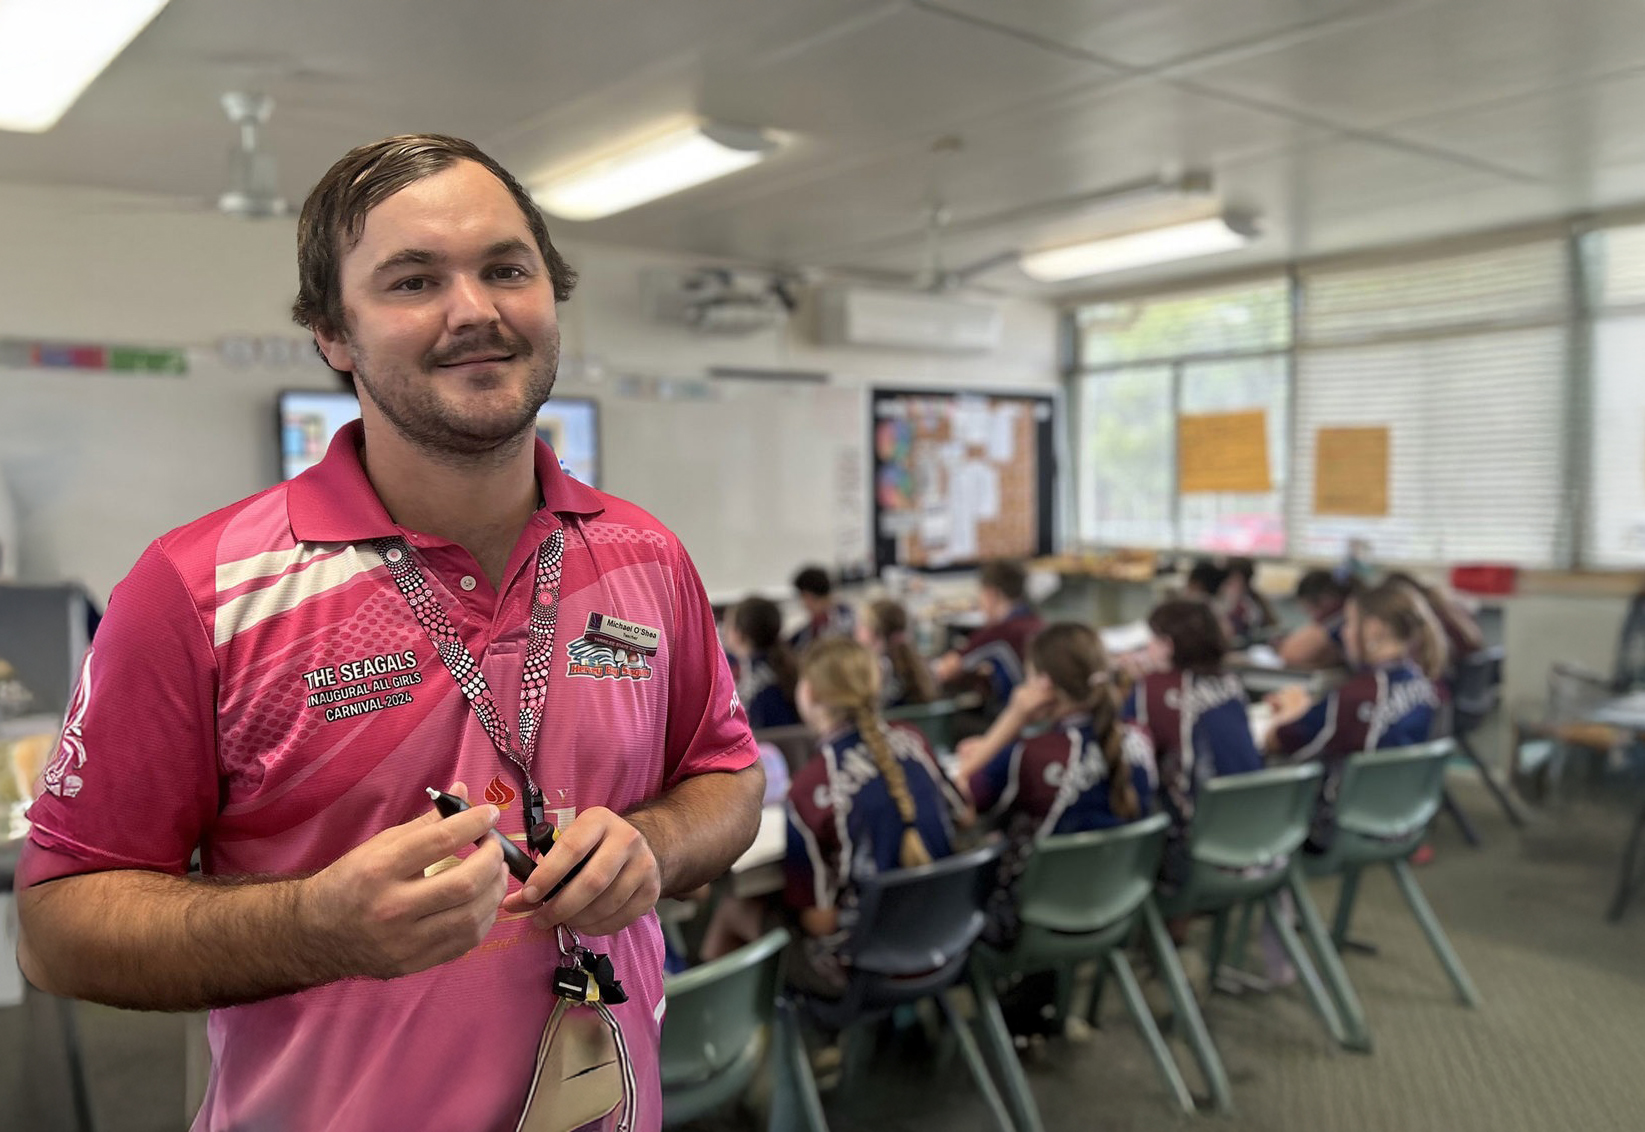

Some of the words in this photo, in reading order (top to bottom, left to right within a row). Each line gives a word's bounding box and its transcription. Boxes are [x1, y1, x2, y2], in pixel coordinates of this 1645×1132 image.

[606, 618, 632, 632] Michael
[633, 626, 657, 639] O'Shea
[304, 667, 336, 690] THE
[341, 650, 418, 682] SEAGALS
[307, 684, 370, 708] INAUGURAL
[373, 678, 391, 692] ALL
[392, 672, 423, 688] GIRLS
[325, 697, 384, 722] CARNIVAL
[385, 692, 413, 708] 2024
